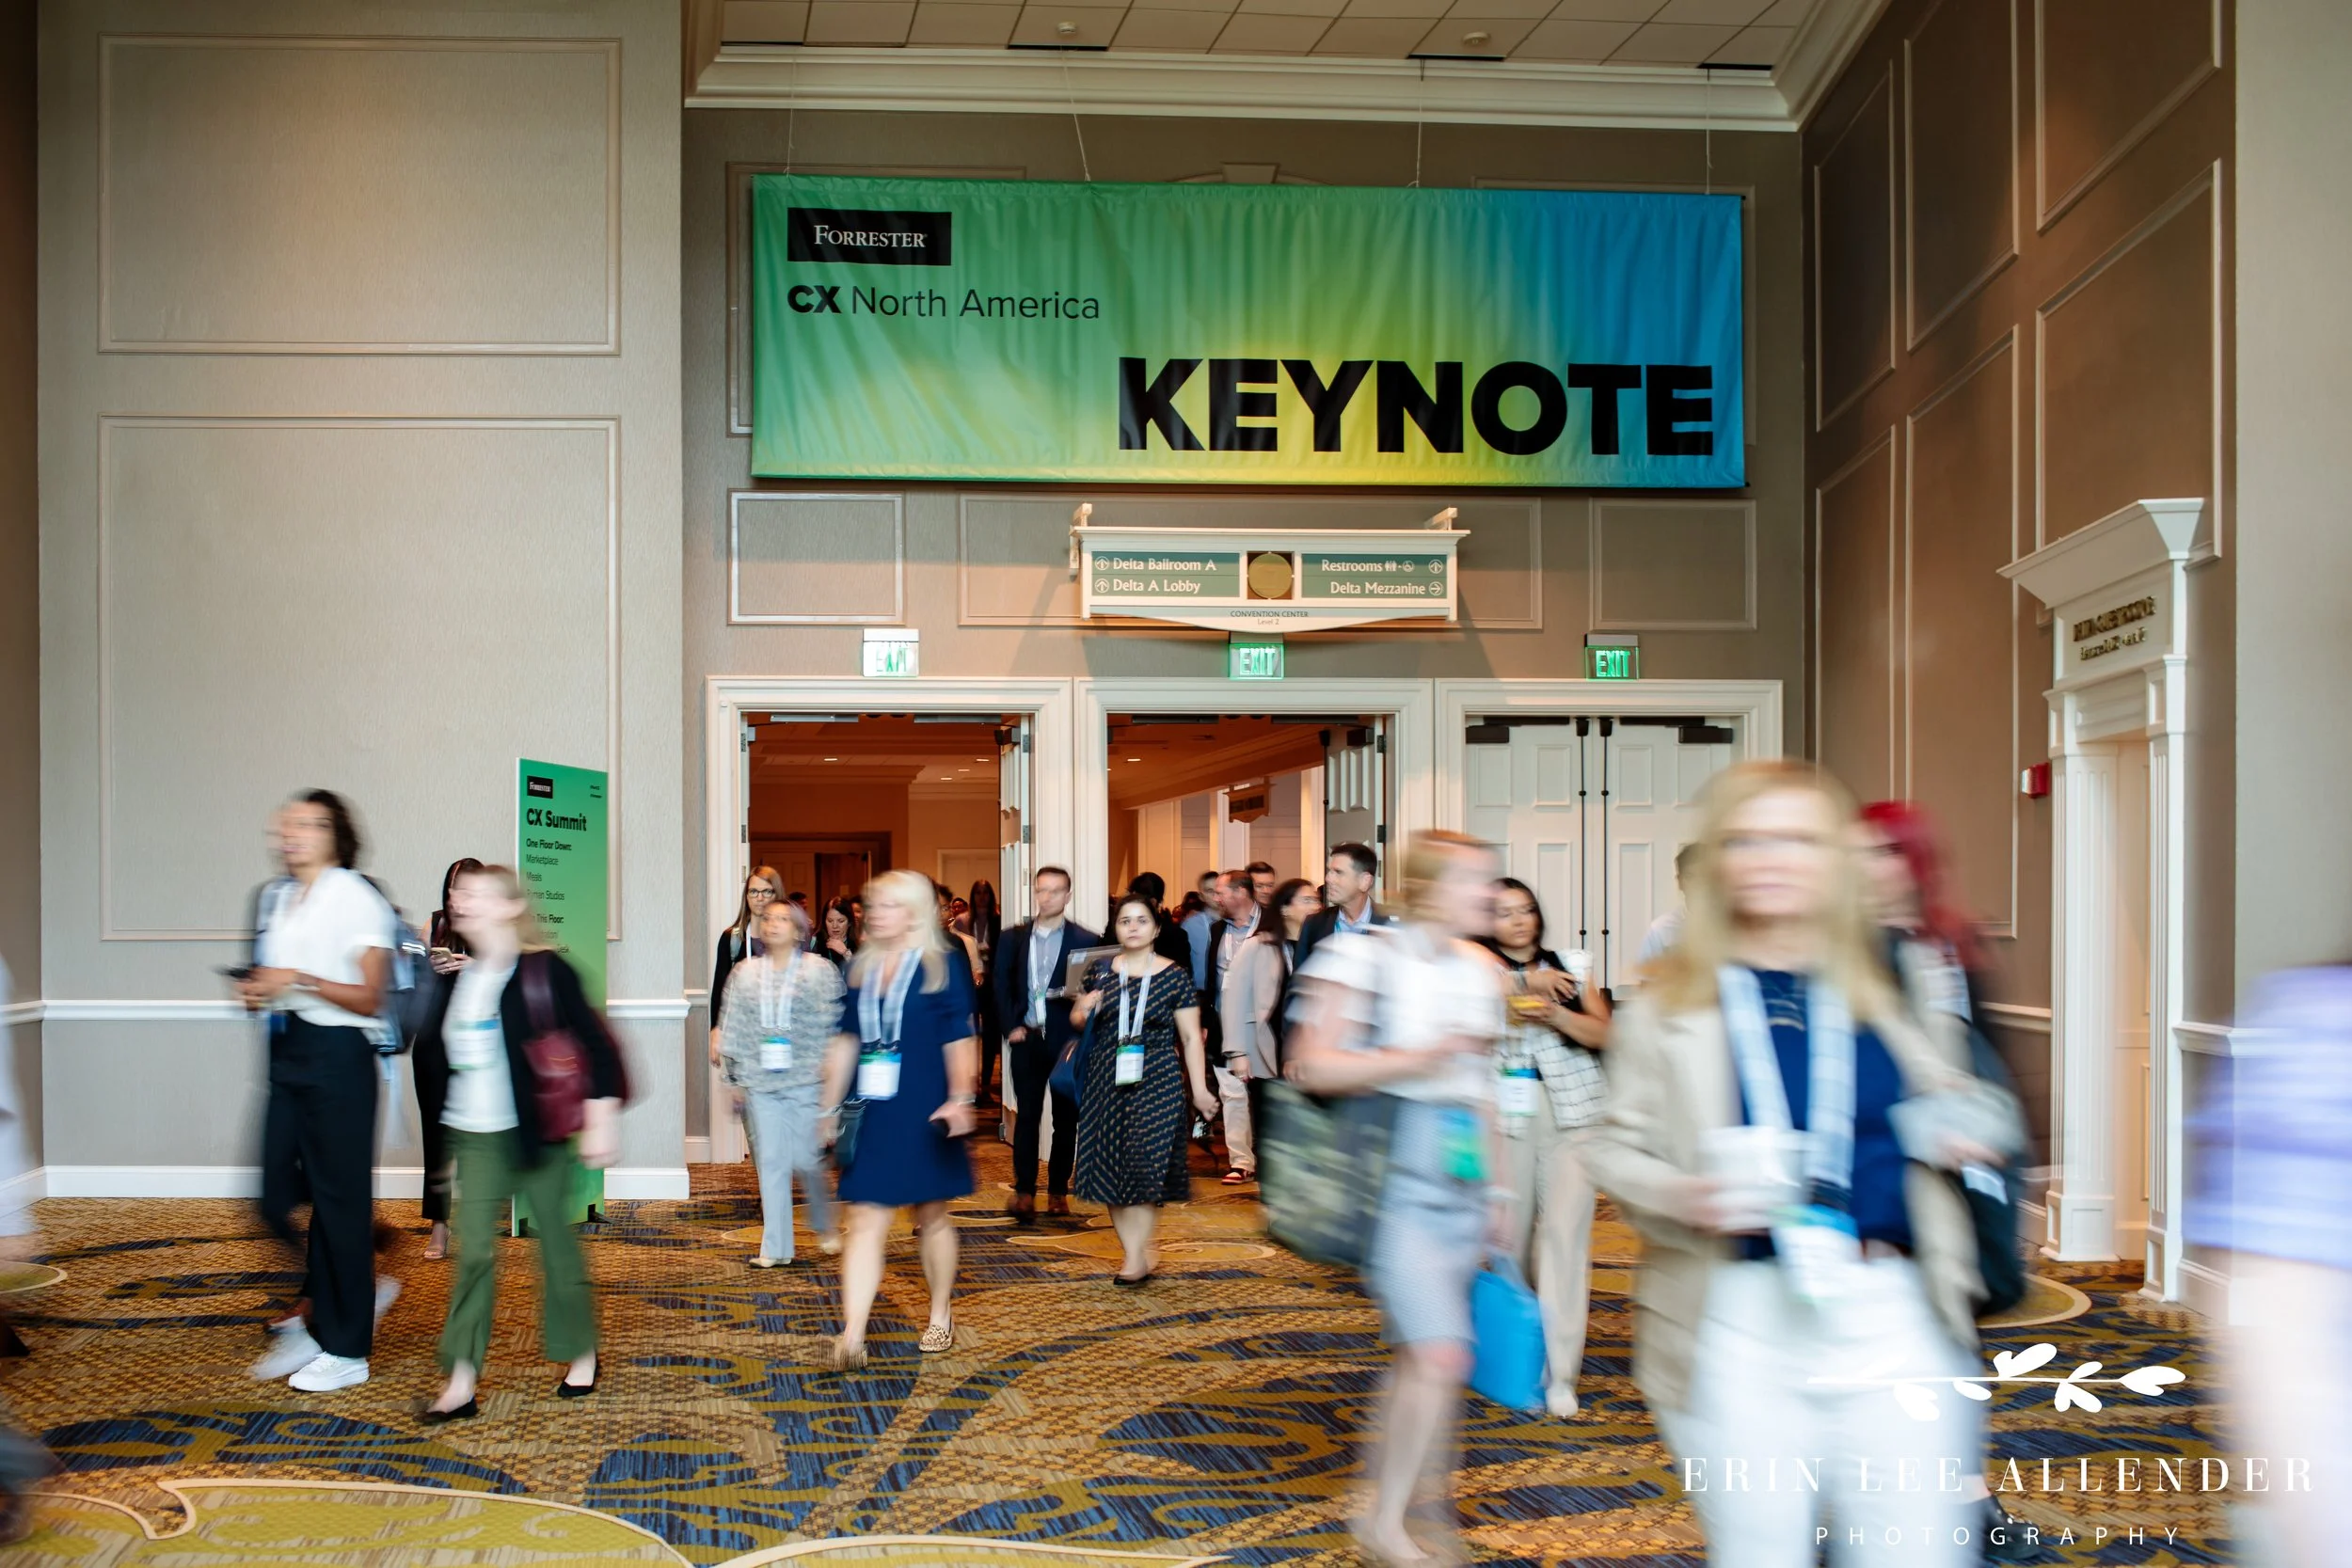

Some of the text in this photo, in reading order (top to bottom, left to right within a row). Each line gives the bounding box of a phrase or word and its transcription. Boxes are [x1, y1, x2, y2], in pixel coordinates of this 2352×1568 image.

[787, 284, 1100, 320] CX North America
[1118, 356, 1714, 456] KEYNOTE
[1113, 558, 1216, 571] Delta Ballroom A
[1321, 559, 1383, 572] Restrooms
[1113, 578, 1200, 594] Delta A Lobby
[1330, 581, 1426, 594] Delta Mezzanine
[1239, 647, 1276, 675] EXIT
[1596, 650, 1630, 677] EXIT
[527, 808, 587, 832] CX Summit
[526, 838, 572, 851] One Floor Down:
[526, 854, 559, 866] Marketplace
[526, 872, 543, 882] Meals
[546, 890, 564, 901] Studios
